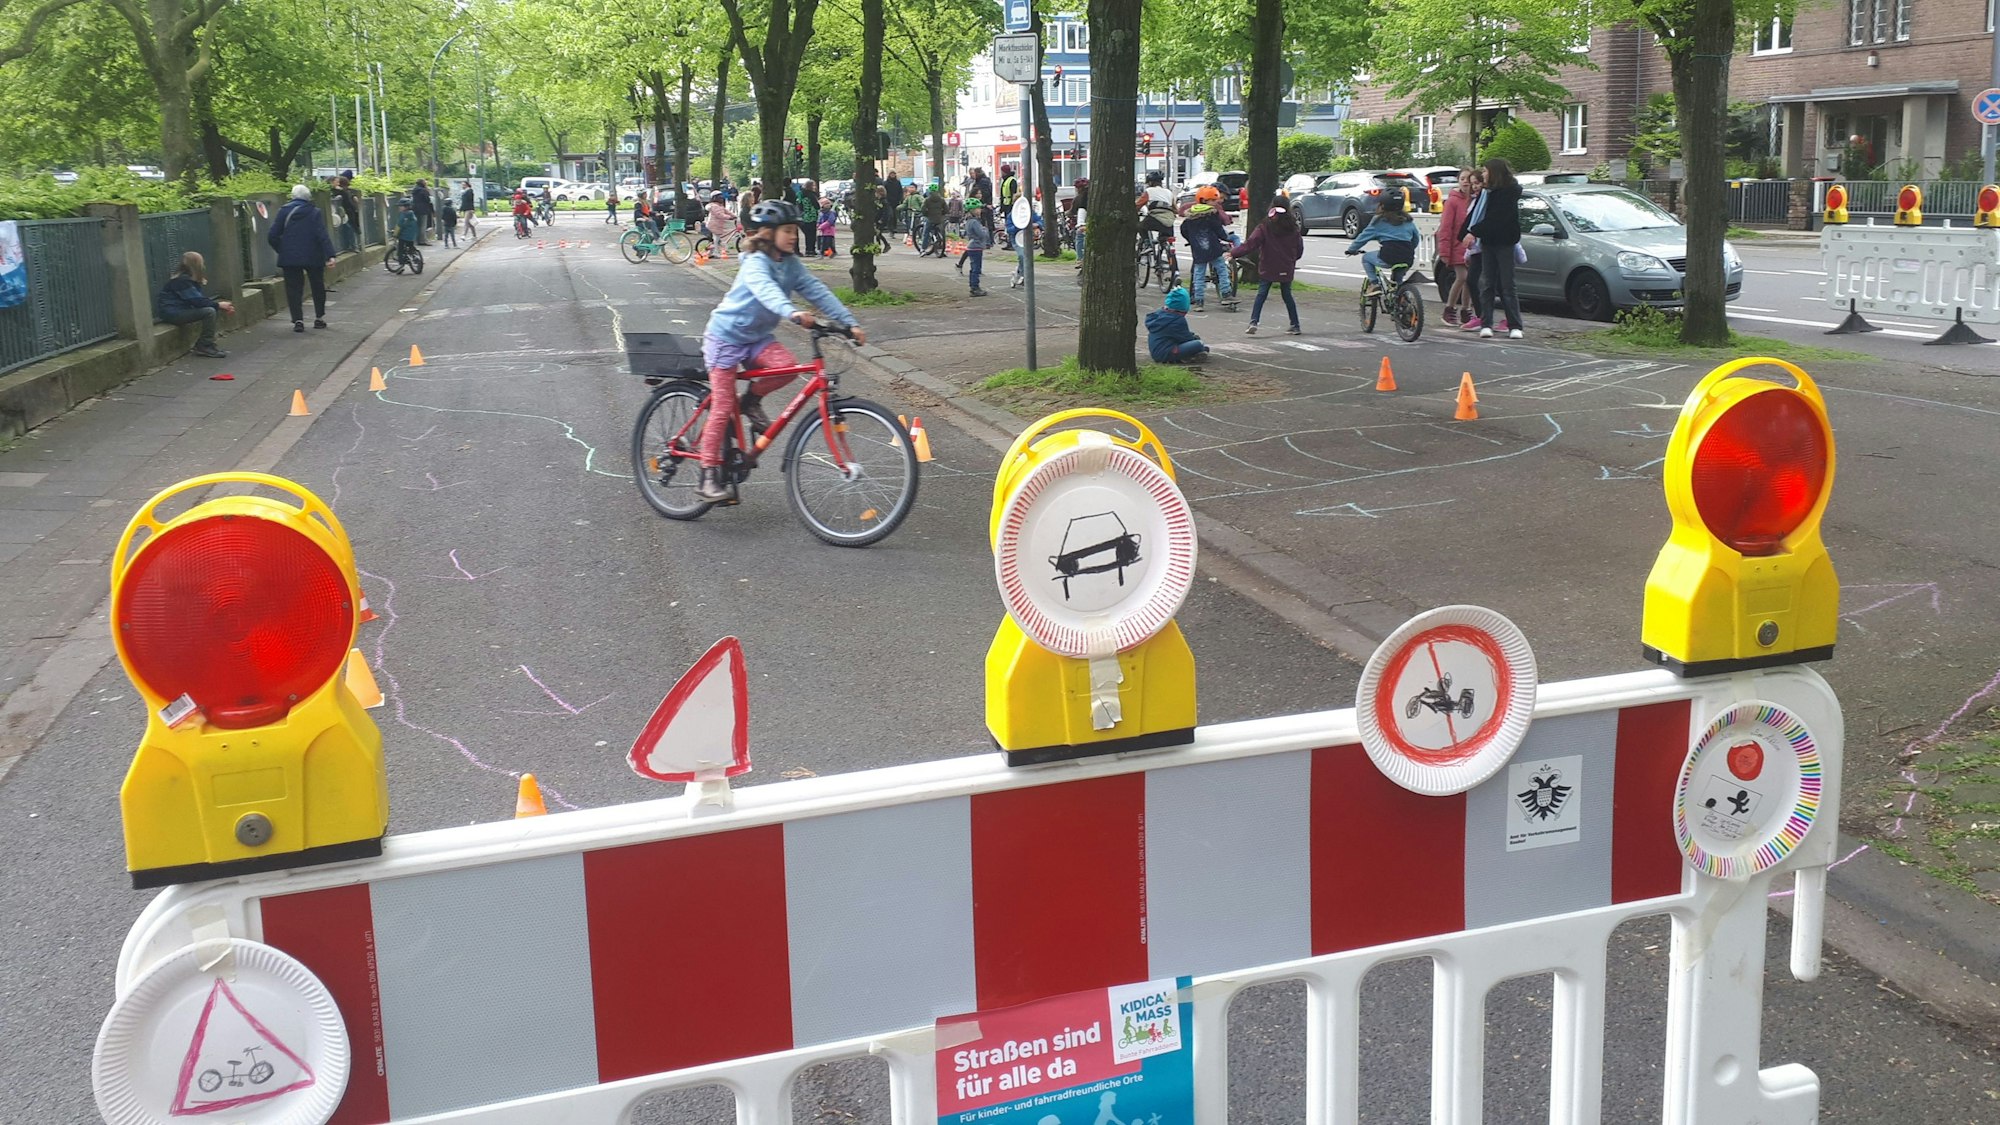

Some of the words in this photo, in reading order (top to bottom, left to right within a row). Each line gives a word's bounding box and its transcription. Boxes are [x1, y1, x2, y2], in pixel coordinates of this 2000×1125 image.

[1135, 1005, 1172, 1023] MASS
[953, 1037, 1049, 1073] Straßen
[1052, 1021, 1101, 1051] sind
[955, 1073, 993, 1100] für
[998, 1064, 1042, 1091] alle
[1047, 1056, 1077, 1080] da
[959, 1112, 976, 1124] Für
[978, 1104, 1012, 1120] kinder-
[1014, 1099, 1033, 1111] und
[1034, 1080, 1121, 1107] fahrradfreundliche
[1122, 1073, 1144, 1085] Orte
